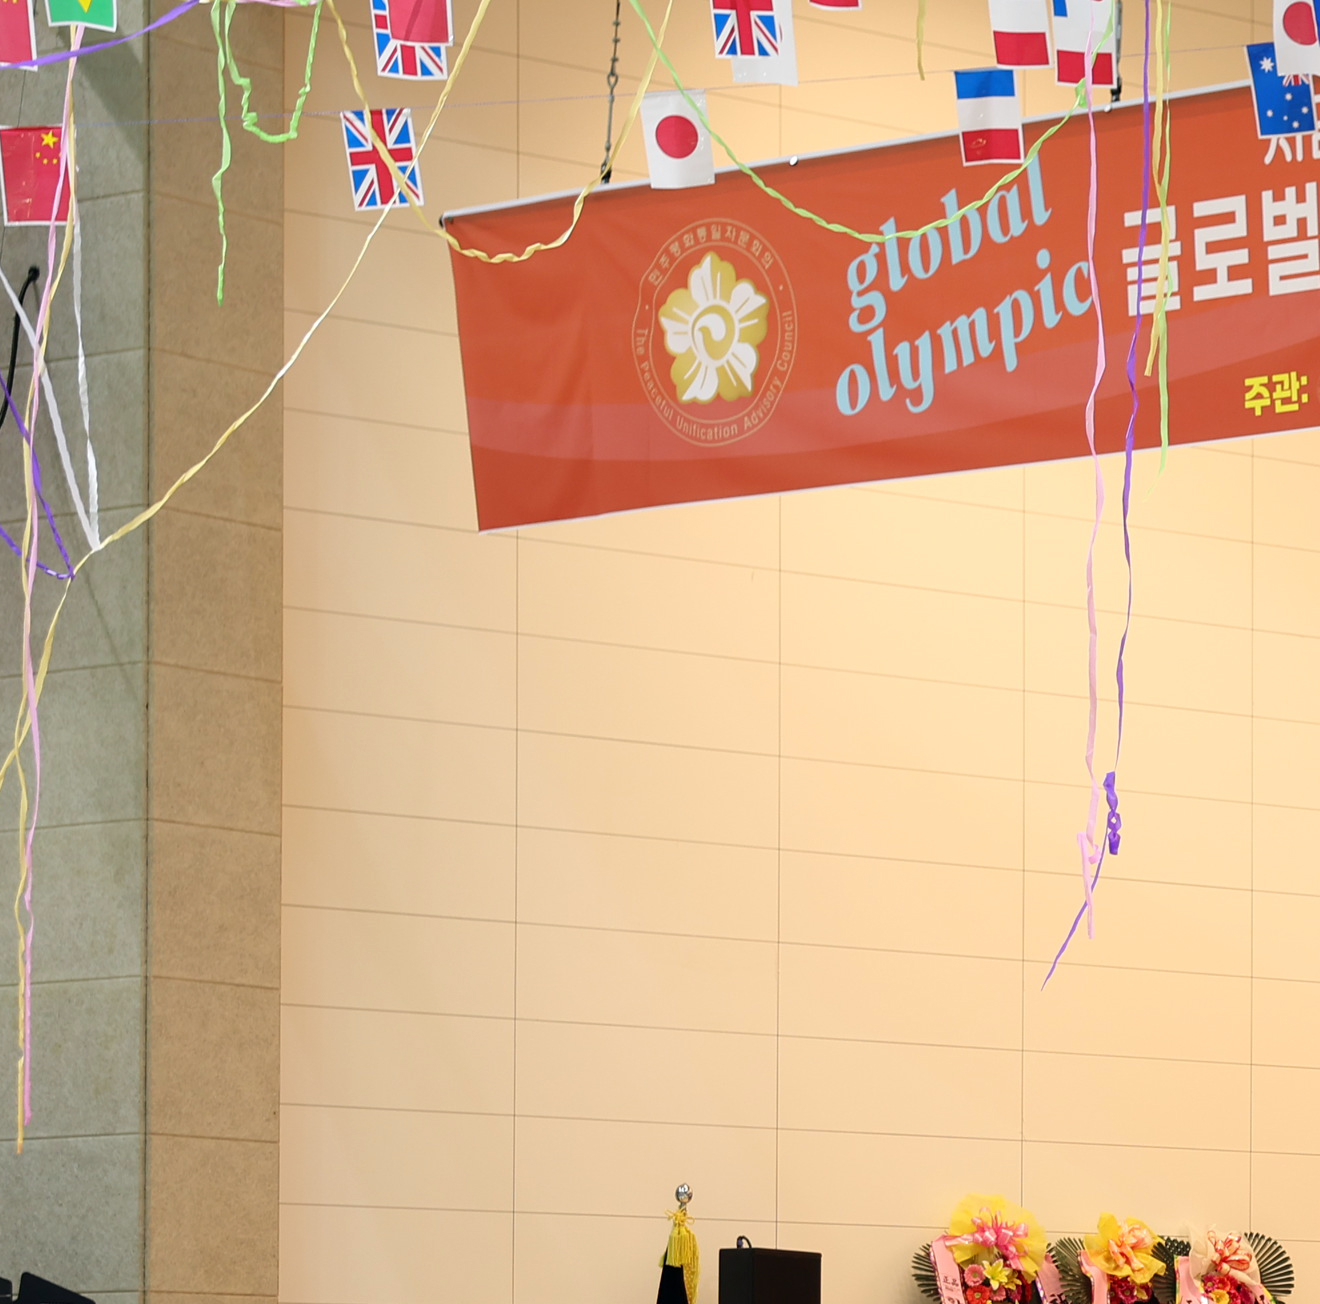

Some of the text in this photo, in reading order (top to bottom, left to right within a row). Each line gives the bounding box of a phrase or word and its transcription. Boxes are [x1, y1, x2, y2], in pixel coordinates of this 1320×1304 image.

[648, 224, 774, 286] 민주평화통일자문회의
[844, 155, 1054, 334] global
[636, 310, 793, 441] The Peaceful Unification Advisory Council
[834, 246, 1093, 416] olympic
[1244, 371, 1309, 417] 주관:
